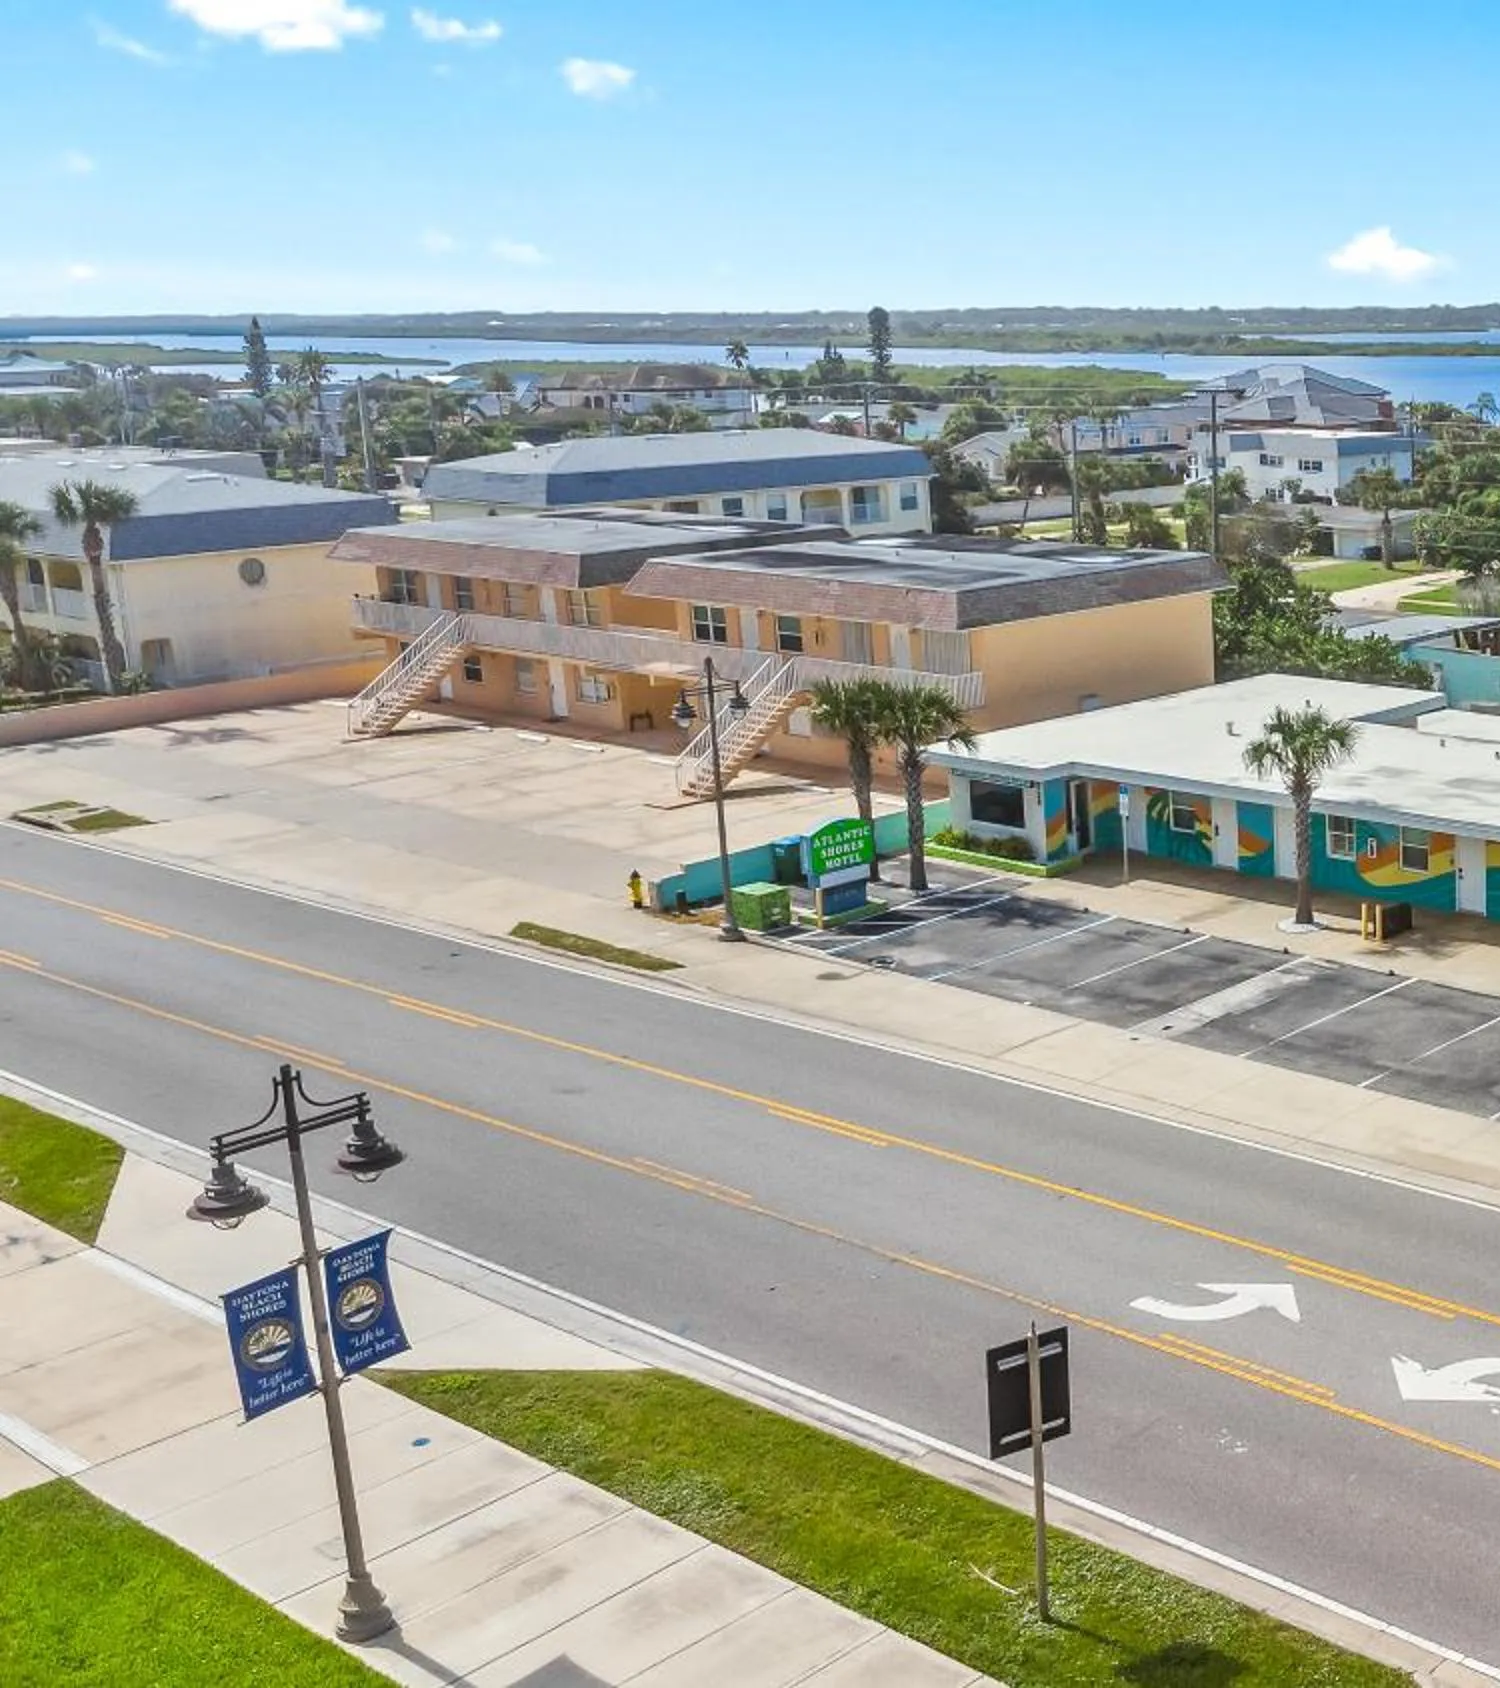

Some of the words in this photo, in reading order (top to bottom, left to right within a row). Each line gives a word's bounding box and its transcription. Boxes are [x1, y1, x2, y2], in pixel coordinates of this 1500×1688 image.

[821, 840, 865, 859] SHORES
[232, 1280, 290, 1307] DAYTONA
[241, 1291, 283, 1312] BEACH
[239, 1299, 287, 1322] SHORES
